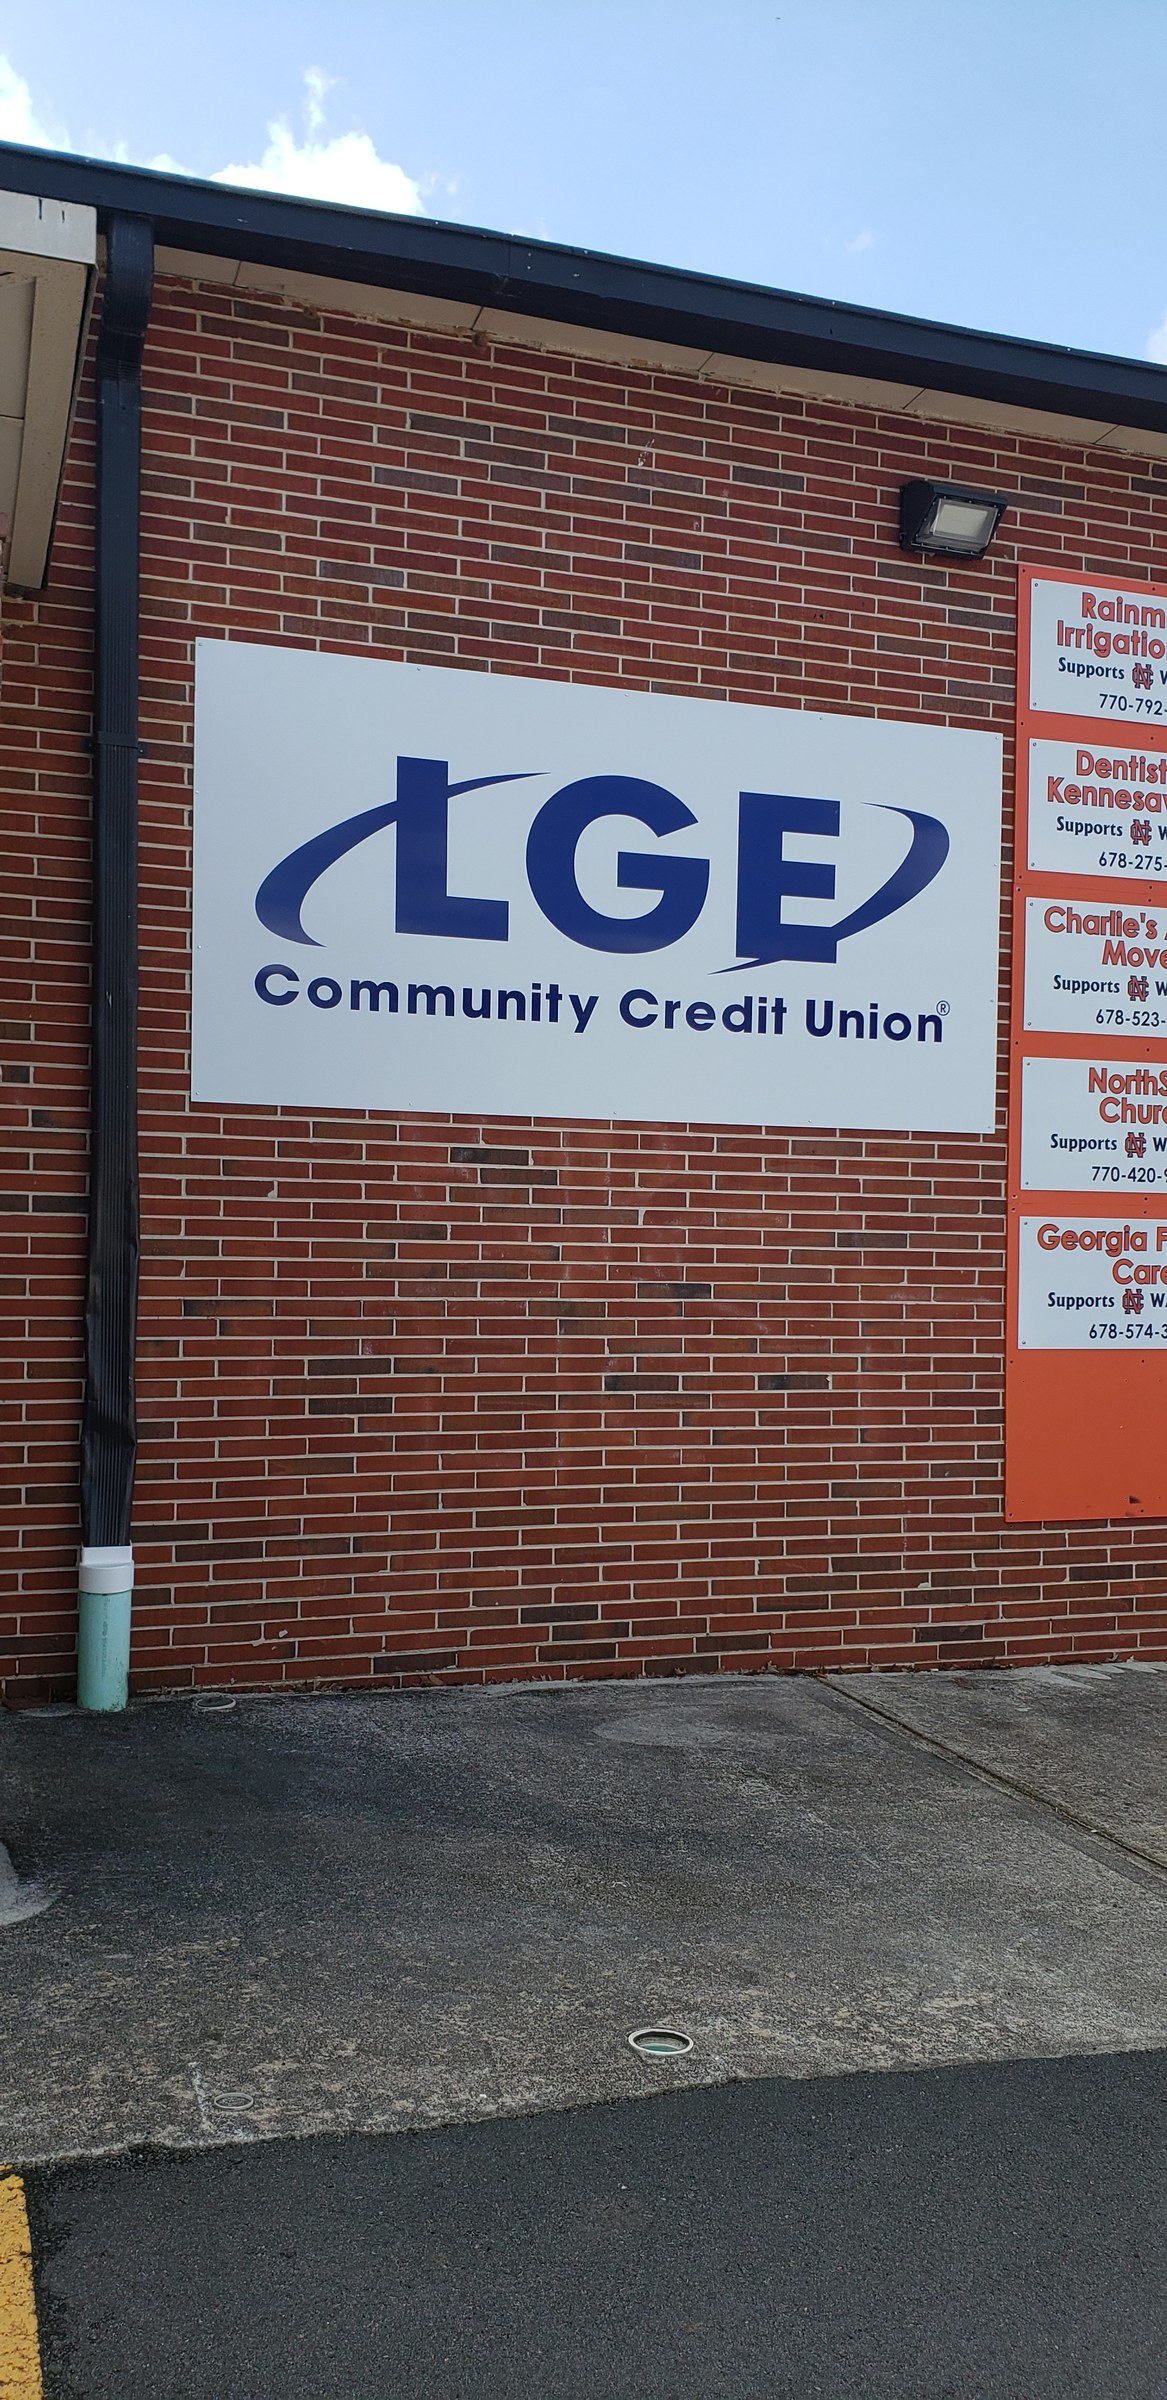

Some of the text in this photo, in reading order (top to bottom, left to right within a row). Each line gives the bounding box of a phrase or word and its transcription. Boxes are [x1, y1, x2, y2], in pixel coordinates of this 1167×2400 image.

[1057, 620, 1167, 660] Irrigatio
[1058, 657, 1125, 679] Supports
[1099, 693, 1167, 716] 770-792-
[1076, 750, 1167, 785] Dentist
[1047, 776, 1167, 813] Kennesa
[1056, 816, 1123, 836] Supports
[395, 755, 841, 964] LGE
[1099, 851, 1167, 872] 678-275-
[1044, 906, 1158, 940] Charlie's
[1053, 974, 1120, 994] Supports
[254, 963, 600, 1034] Community
[619, 989, 788, 1035] Credit
[1096, 1009, 1166, 1027] 678-523-
[1050, 1133, 1117, 1152] Supports
[1037, 1223, 1148, 1257] Georgia
[1048, 1292, 1115, 1310] Supports
[1150, 1293, 1167, 1307] W
[1089, 1324, 1167, 1339] 678-574-3
